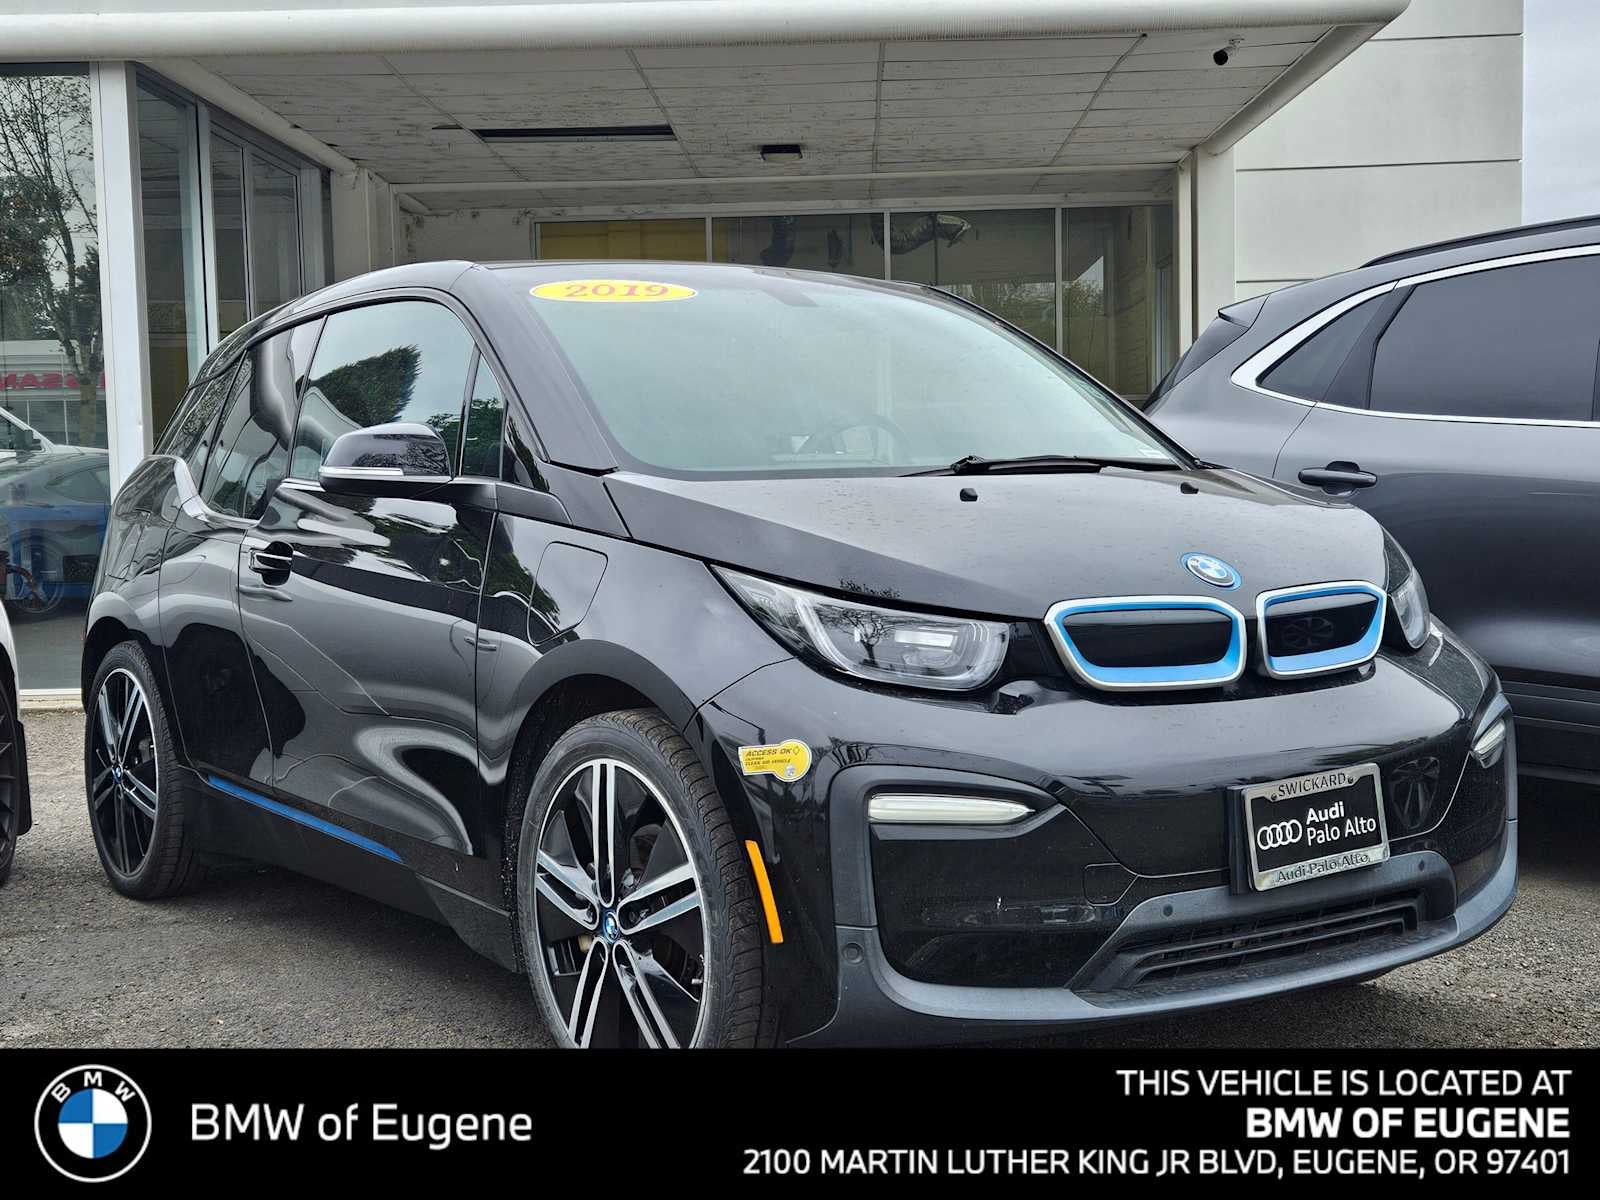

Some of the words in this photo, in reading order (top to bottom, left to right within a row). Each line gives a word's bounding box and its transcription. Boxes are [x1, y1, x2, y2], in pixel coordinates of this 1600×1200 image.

[564, 284, 669, 298] 2019
[746, 748, 777, 757] ACCESS
[1278, 772, 1346, 797] SWICKARD
[1306, 801, 1345, 825] Audi
[1307, 824, 1340, 846] Palo
[1345, 816, 1377, 838] Alto
[1278, 866, 1310, 883] Audi
[1309, 860, 1337, 874] Palo
[1341, 853, 1370, 867] Alto
